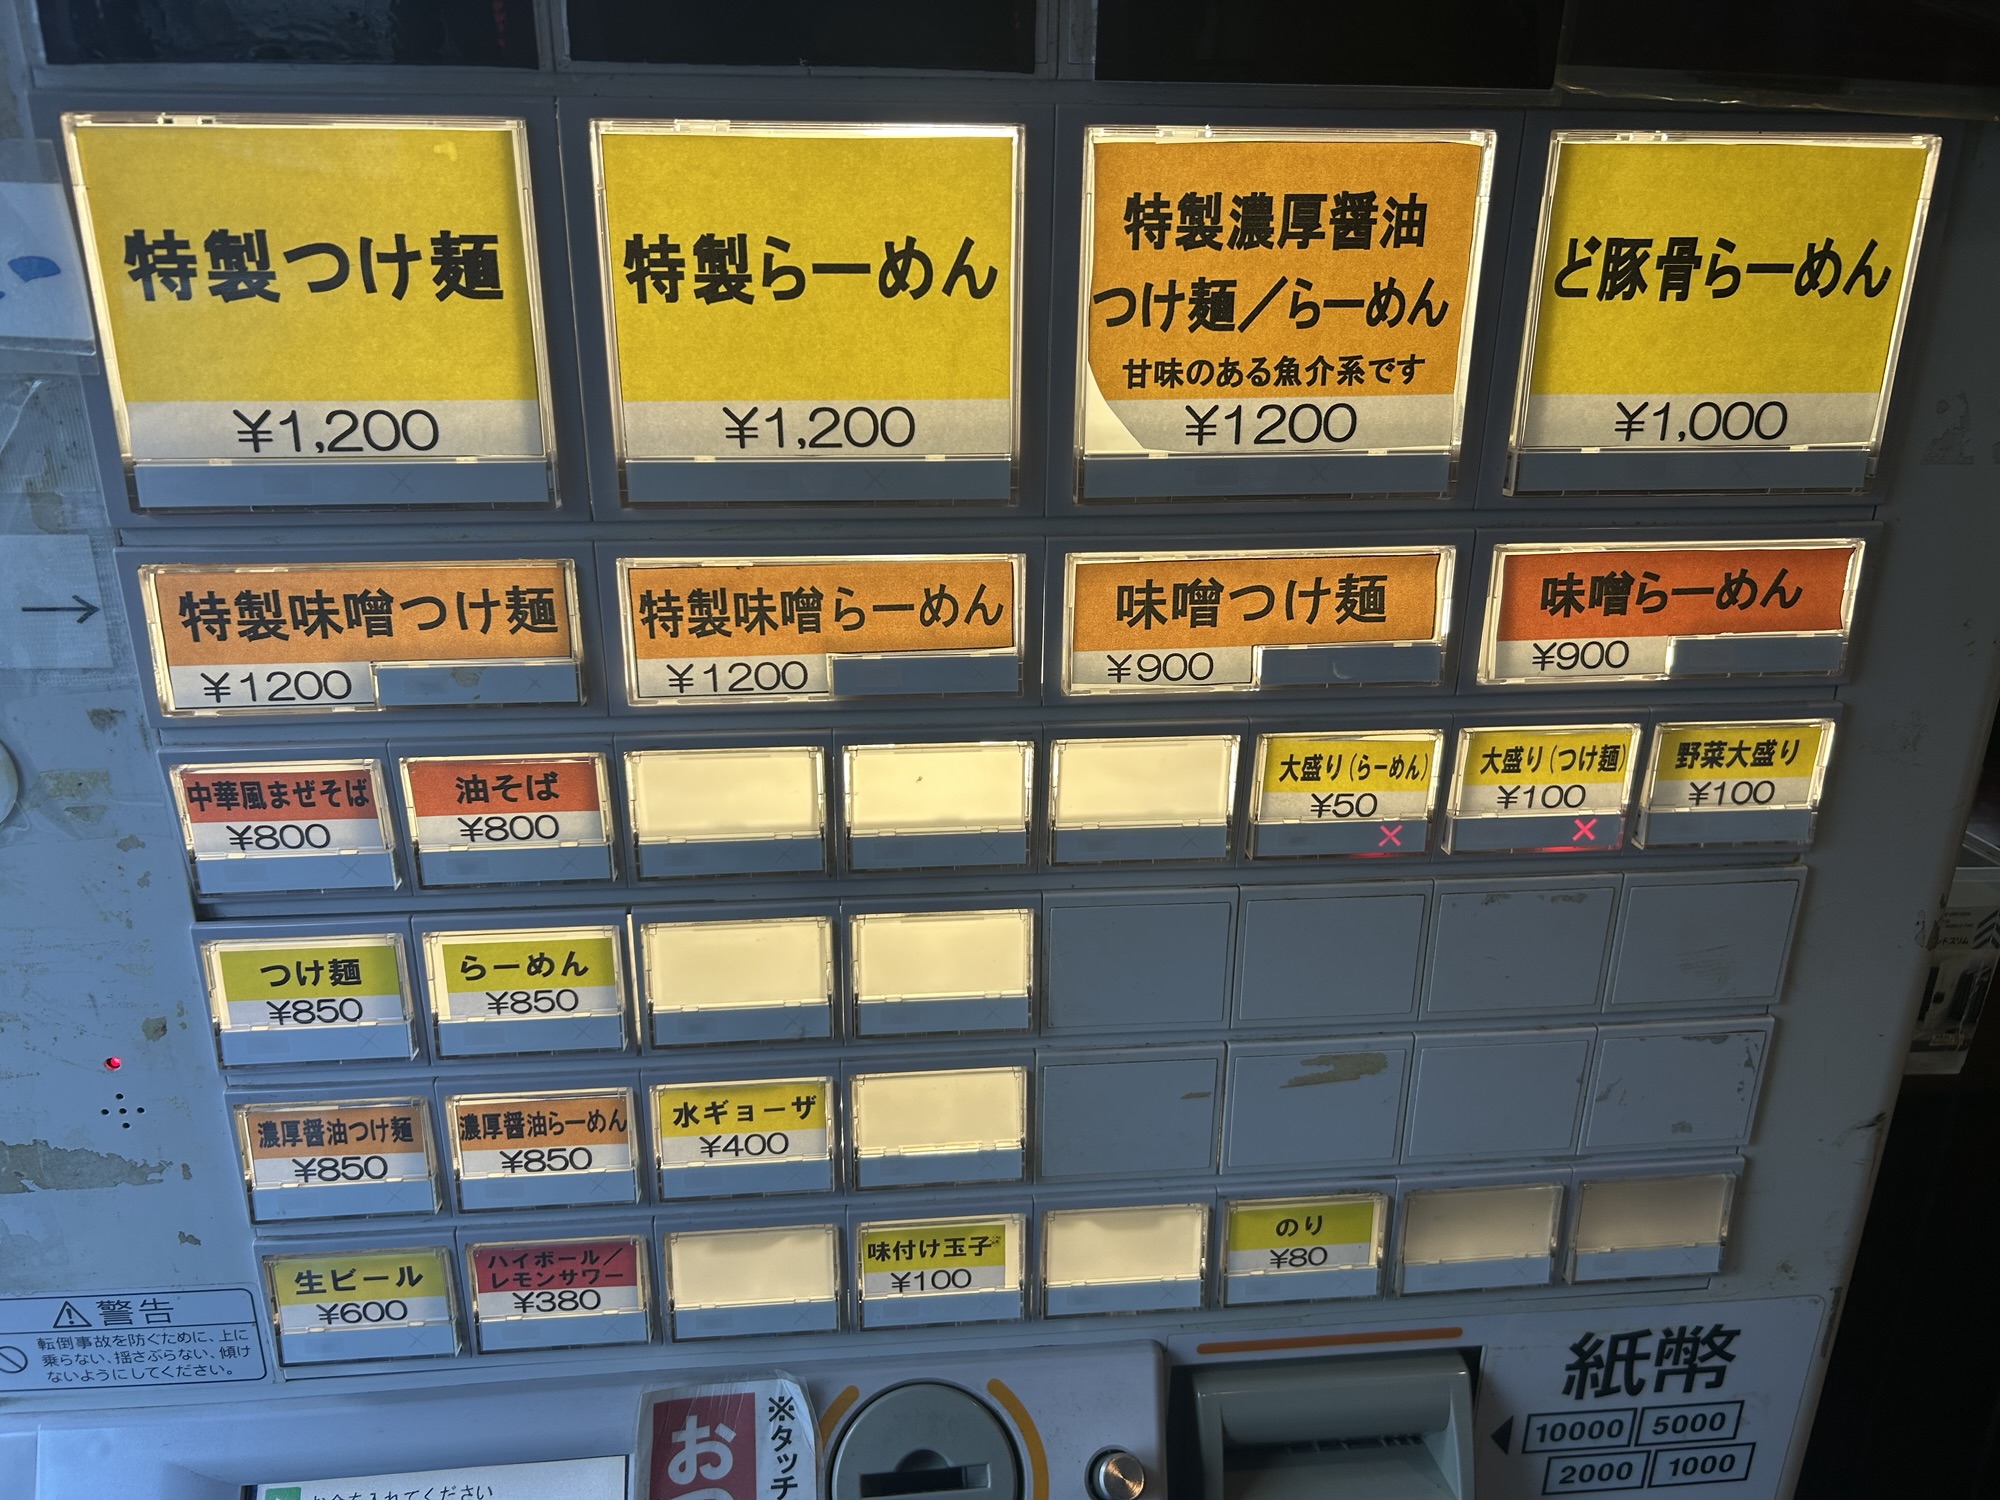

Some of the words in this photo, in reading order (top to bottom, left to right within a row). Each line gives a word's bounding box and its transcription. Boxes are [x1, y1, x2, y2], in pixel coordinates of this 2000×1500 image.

[1124, 191, 1428, 250] 特製濃厚醤油
[124, 229, 503, 302] 特製つけ麺
[623, 233, 998, 305] 特製らーめん
[1554, 236, 1892, 302] ど豚骨らーめん
[1093, 276, 1448, 333] つけ麺／らーめん
[1123, 355, 1425, 389] 甘味のある魚介系です
[233, 409, 440, 455] ¥1,200
[723, 406, 915, 451] ¥1,200
[1185, 403, 1357, 446] ¥1200
[1615, 400, 1787, 443] ¥1,000
[1116, 573, 1388, 630] 味噌つけ麺
[1540, 567, 1803, 617] 味噌らーめん
[179, 585, 558, 643] 特製味噌つけ麺
[639, 583, 1004, 639] 特製味噌らーめん
[1106, 652, 1214, 684] ¥900
[1532, 640, 1629, 672] ¥900
[201, 670, 352, 702] ¥1200
[667, 661, 808, 693] ¥1200
[1676, 737, 1801, 770] 野菜大盛り
[188, 779, 370, 811] 中華風まぜそば
[455, 771, 560, 804] 油そば
[1497, 784, 1586, 810] ¥100
[1688, 780, 1775, 807] ¥100
[1310, 792, 1378, 818] ¥50
[226, 823, 331, 851] ¥800
[458, 814, 560, 843] ¥800
[260, 958, 363, 988] つけ麺
[460, 951, 589, 982] らーめん
[266, 997, 363, 1026] ¥850
[486, 988, 579, 1015] ¥850
[460, 1108, 627, 1141] 濃厚醤油らーめん
[672, 1094, 817, 1128] 水ギョーザ
[258, 1116, 414, 1149] 濃厚醤油つけ麺
[700, 1132, 789, 1158] ¥400
[292, 1155, 388, 1182] ¥850
[500, 1147, 592, 1174] ¥850
[1275, 1215, 1323, 1236] のり
[868, 1236, 991, 1261] 味付け玉子
[1269, 1246, 1328, 1268] ¥80
[295, 1265, 423, 1295] 生ビール
[492, 1269, 623, 1289] レモンサワー
[891, 1268, 971, 1292] ¥100
[97, 1298, 174, 1326] 警告
[318, 1300, 408, 1325] ¥600
[513, 1289, 601, 1313] ¥380
[37, 1328, 249, 1351] 転倒事故を防ぐために、上に
[41, 1345, 251, 1368] 乗らない、揺さぶらない、傾け
[1562, 1323, 1741, 1400] 紙幣
[47, 1364, 234, 1383] ないようにしてください。
[1536, 1417, 1625, 1444] 10000
[1651, 1411, 1726, 1436] 5000
[668, 1415, 737, 1500] お
[1558, 1460, 1634, 1485] 2000
[1668, 1453, 1736, 1477] 1000
